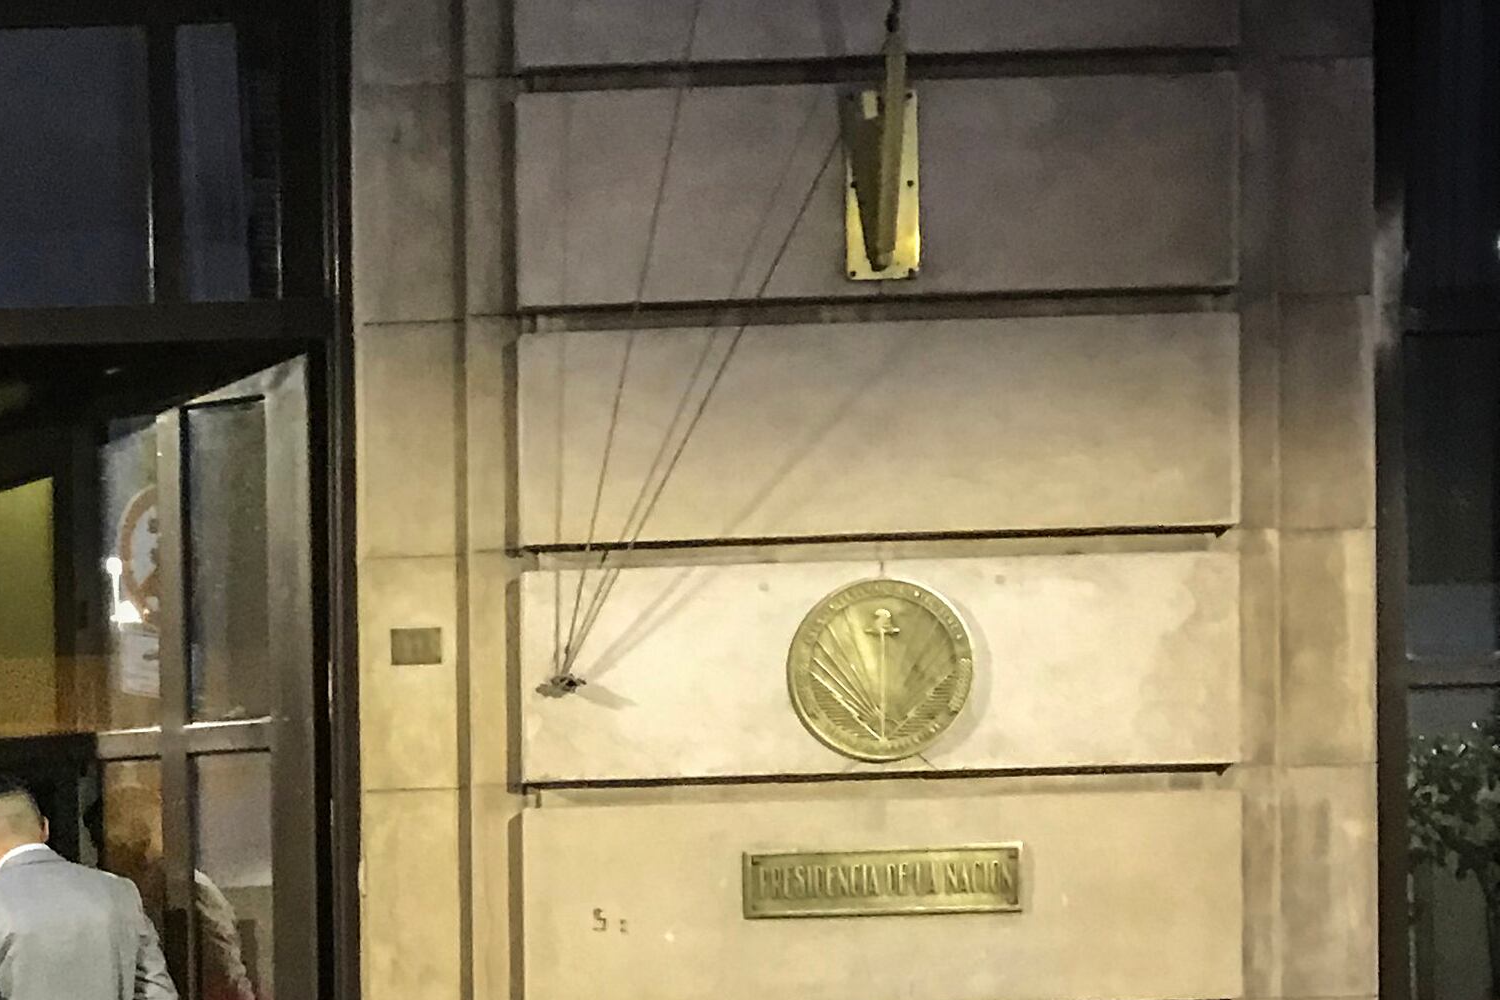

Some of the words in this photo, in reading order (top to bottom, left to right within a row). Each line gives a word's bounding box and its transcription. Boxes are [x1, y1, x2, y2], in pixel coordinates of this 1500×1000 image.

[758, 863, 880, 897] PRESIDENCIA
[886, 862, 908, 894] DE
[915, 861, 938, 894] LA
